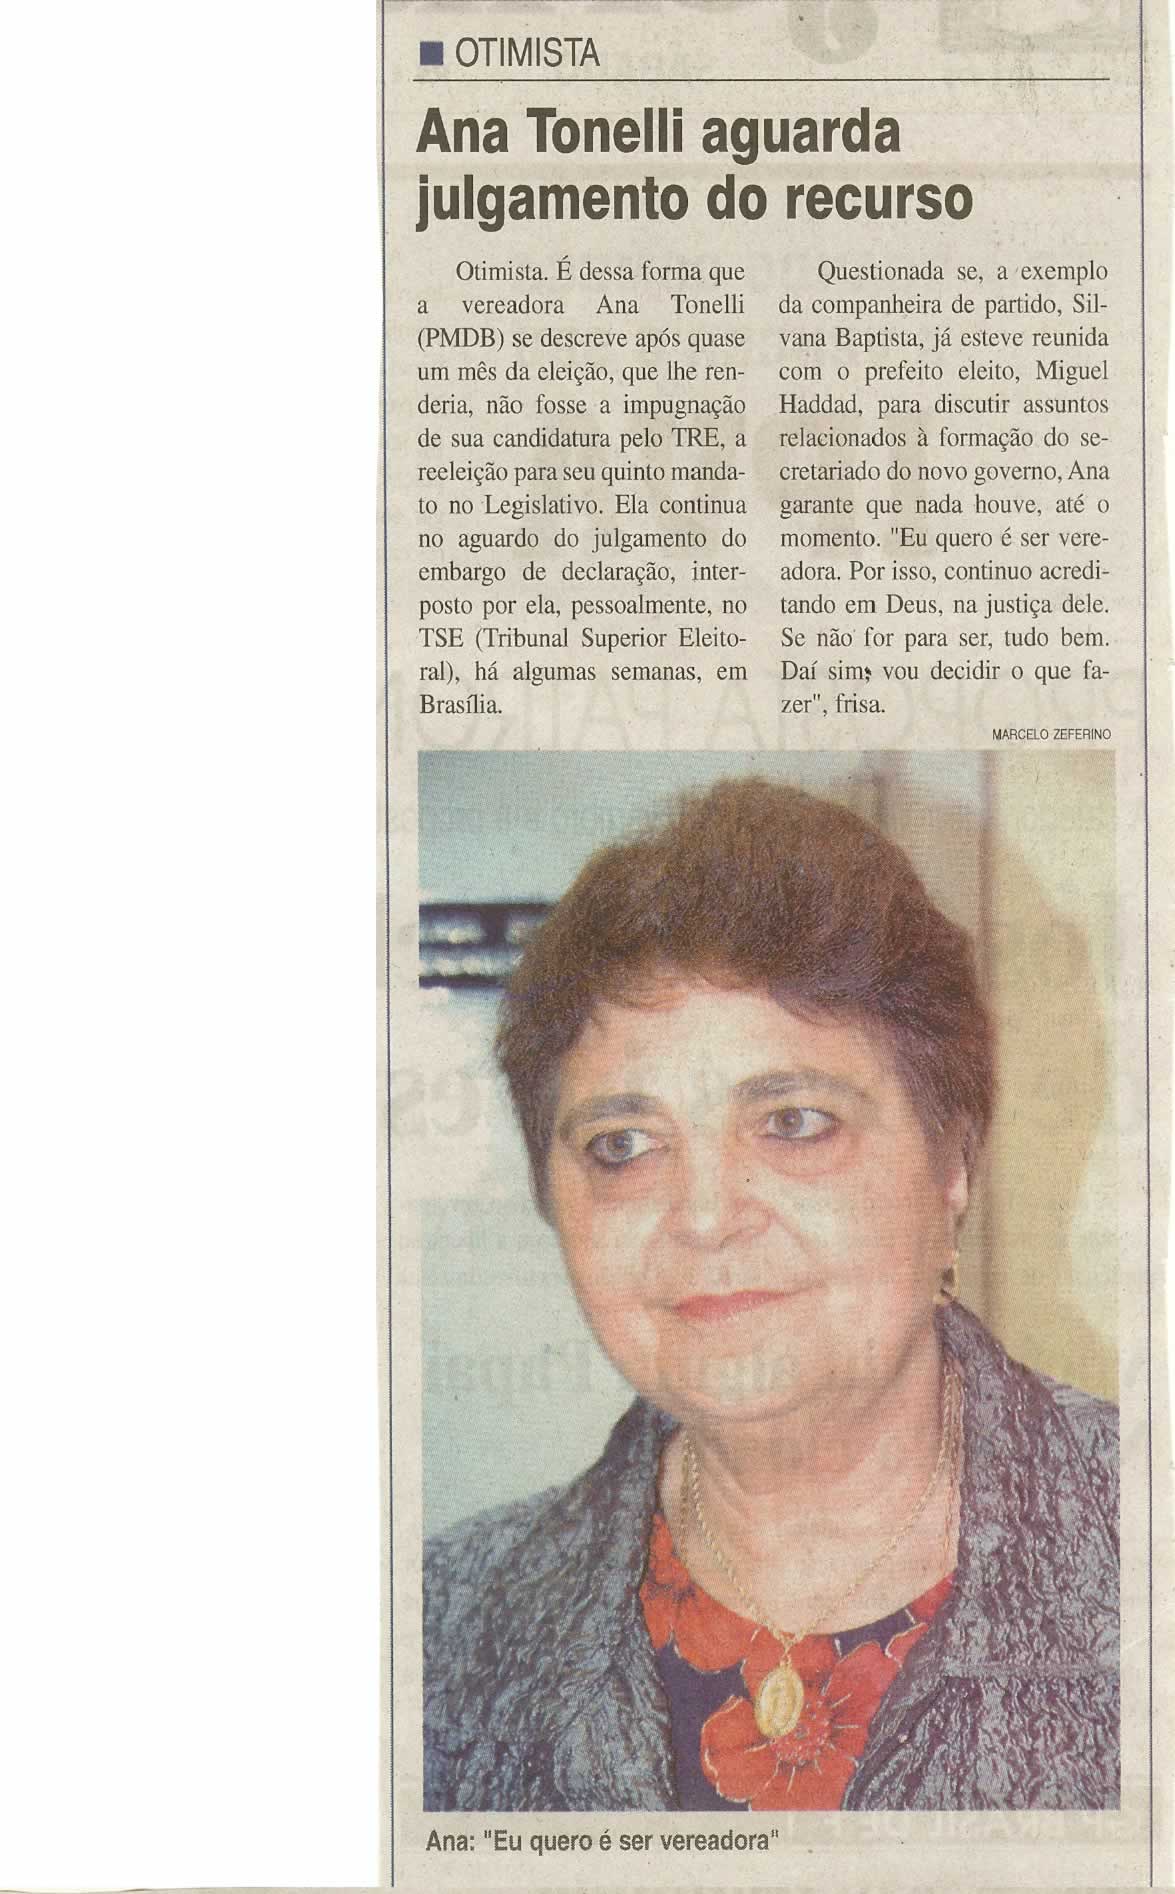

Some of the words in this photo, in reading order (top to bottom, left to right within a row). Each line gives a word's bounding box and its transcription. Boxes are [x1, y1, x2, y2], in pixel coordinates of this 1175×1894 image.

[455, 36, 601, 68] OTIMISTA
[415, 106, 509, 154] Ana
[525, 106, 683, 154] Tonelli
[702, 106, 901, 166] aguarda
[415, 173, 689, 233] julgamento
[706, 173, 768, 221] do
[786, 183, 974, 221] recurso
[455, 260, 549, 281] Otimista.
[556, 254, 573, 281] É
[579, 260, 635, 281] dessa
[641, 259, 703, 281] forma
[708, 266, 745, 287] que
[817, 259, 945, 286] Questionada
[957, 266, 984, 284] se,
[997, 265, 1009, 281] a
[1020, 259, 1108, 287] exemplo
[417, 393, 474, 418] deria,
[486, 394, 523, 415] não
[535, 393, 588, 415] fosse
[599, 399, 612, 415] a
[623, 393, 746, 420] impugnação
[778, 393, 863, 417] Haddad,
[877, 399, 922, 420] para
[934, 392, 1011, 414] discutir
[1023, 395, 1109, 414] assuntos
[418, 533, 444, 549] no
[458, 527, 539, 554] aguardo
[553, 527, 579, 548] do
[591, 527, 707, 554] julgamento
[721, 527, 747, 548] do
[780, 559, 841, 581] adora.
[848, 560, 886, 581] Por
[891, 559, 937, 584] isso,
[944, 559, 1033, 581] continuo
[1039, 559, 1110, 581] acredi-
[418, 627, 464, 648] TSE
[475, 626, 569, 652] (Tribunal
[581, 626, 668, 654] Superior
[677, 626, 747, 648] Eleito-
[780, 693, 828, 718] zer",
[835, 692, 886, 714] frisa.
[992, 728, 1049, 741] MARCELO
[1053, 728, 1112, 741] ZEFERINO
[425, 1829, 475, 1852] Ana:
[483, 1829, 522, 1852] "Eu
[529, 1834, 593, 1857] quero
[599, 1828, 612, 1852] é
[619, 1833, 654, 1852] ser
[659, 1828, 779, 1852] vereadora"
